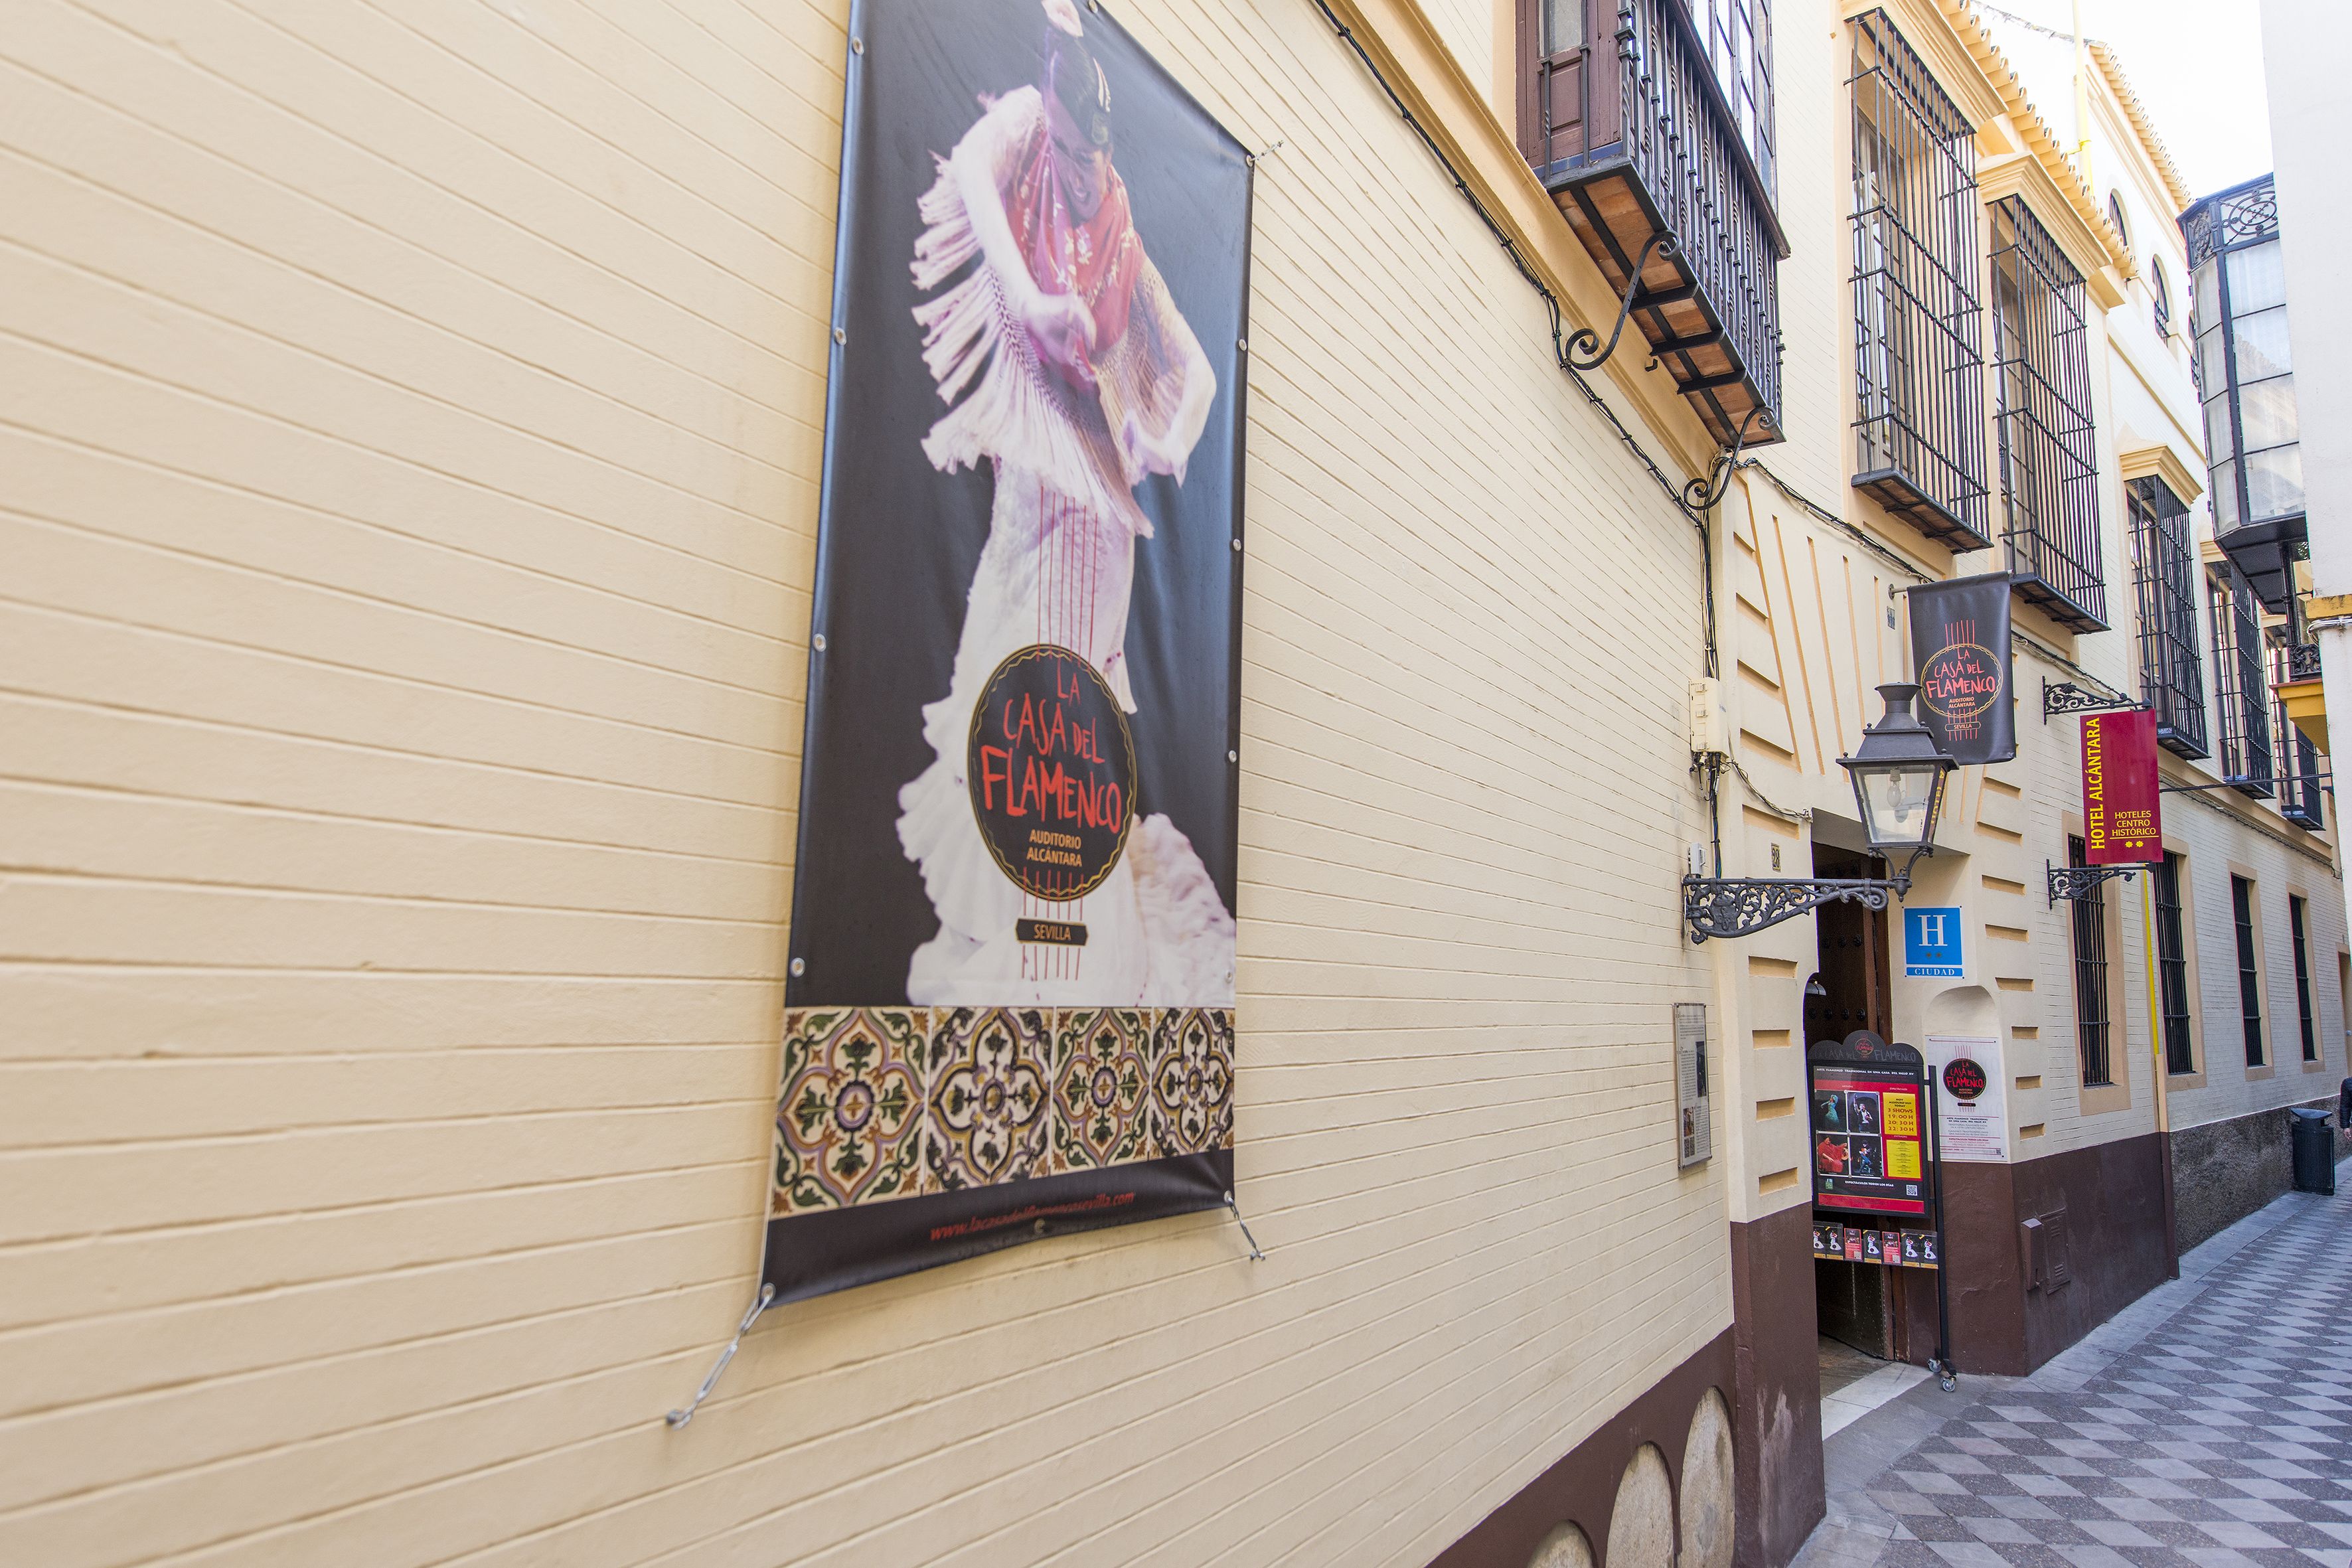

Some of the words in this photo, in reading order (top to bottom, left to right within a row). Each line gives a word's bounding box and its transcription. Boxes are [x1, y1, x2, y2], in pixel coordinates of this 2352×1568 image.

[1958, 647, 1970, 661] LA
[1934, 661, 1964, 679] CASA
[1966, 659, 1985, 674] DEL
[1056, 663, 1082, 707] LA
[1926, 676, 1996, 698] FLAMENCO
[1003, 692, 1067, 757] CASA
[1073, 716, 1105, 763] DEL
[2084, 717, 2103, 801] ALCÁNTARA
[980, 745, 1122, 834] FLAMENCO
[2114, 811, 2152, 819] HOTELES
[2116, 819, 2150, 828] CENTRO
[2090, 804, 2105, 849] HOTEL
[2112, 827, 2156, 836] HISTÓRICO
[1029, 829, 1081, 850] AUDITORIO
[1026, 846, 1083, 867] ALCÁNTARA
[1772, 848, 1779, 868] 28
[1034, 923, 1071, 941] SEVILLA
[1918, 915, 1948, 946] H
[1873, 1050, 1916, 1061] FLAMENCO
[1950, 1067, 1966, 1077] CASA
[1946, 1077, 1984, 1088] FLAMENCO
